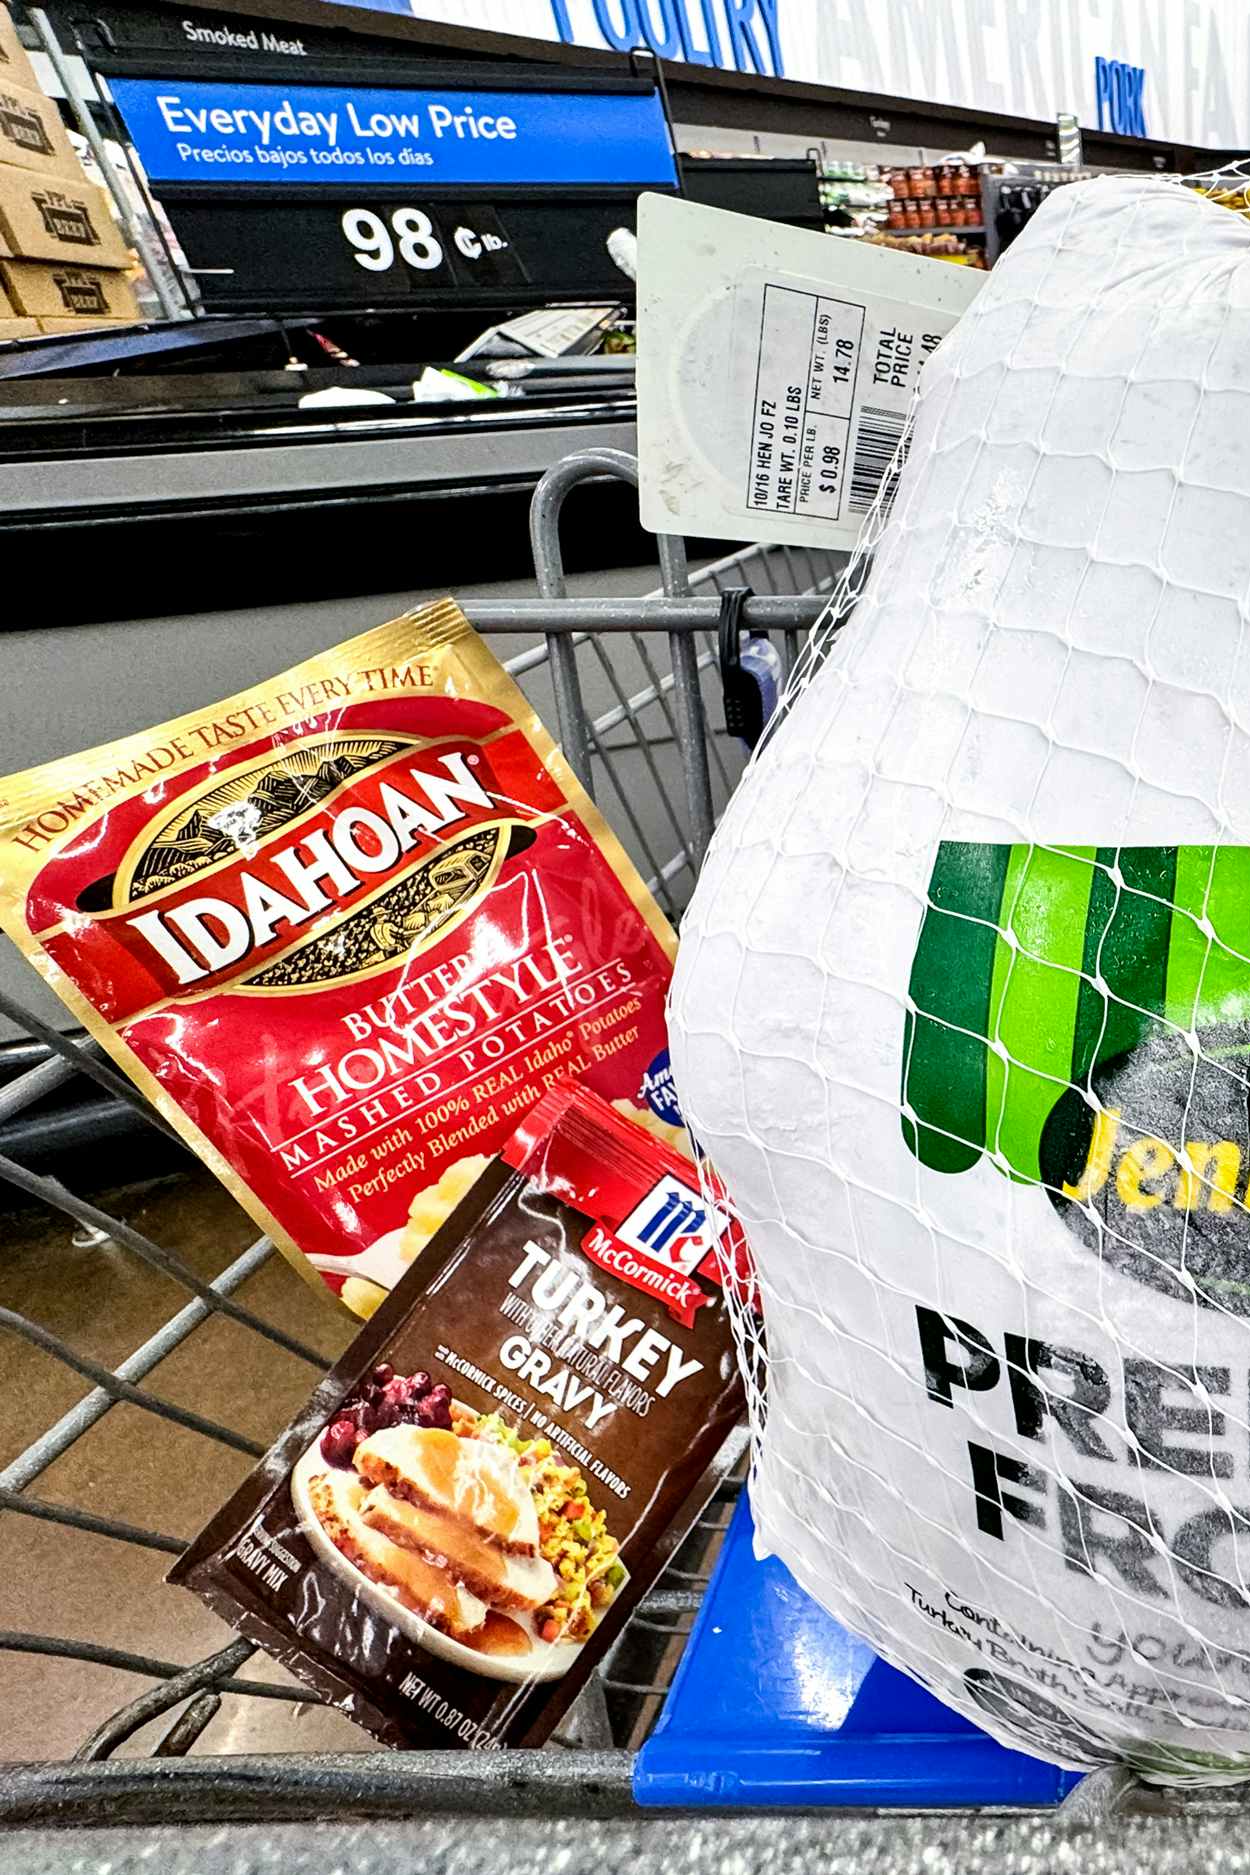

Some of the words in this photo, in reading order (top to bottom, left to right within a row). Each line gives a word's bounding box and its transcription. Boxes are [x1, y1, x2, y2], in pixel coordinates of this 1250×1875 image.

[182, 21, 258, 50] Smoked
[262, 34, 307, 56] Meat
[1095, 56, 1146, 138] PORK
[157, 96, 337, 145] Everyday
[347, 103, 422, 138] Low
[430, 105, 517, 140] Price
[177, 142, 253, 163] Precios
[256, 146, 306, 168] bajos
[309, 148, 364, 165] todos
[366, 148, 395, 165] los
[398, 148, 433, 166] días
[342, 208, 444, 272] 98
[816, 314, 832, 345] (LBS)
[813, 351, 827, 374] WT.
[832, 338, 855, 383] 14.78
[873, 327, 896, 384] TOTAL
[891, 332, 913, 388] PRICE
[761, 400, 776, 419] FZ
[786, 385, 802, 412] LBS
[810, 377, 823, 400] NET
[760, 421, 775, 439] JO
[782, 416, 798, 444] 0.10
[806, 424, 817, 443] LB.
[757, 442, 773, 469] HEN
[780, 448, 795, 473] WT.
[802, 444, 814, 468] PER
[820, 445, 840, 480] 0.98
[754, 473, 770, 507] 10/16
[776, 477, 793, 509] TARE
[799, 472, 812, 503] PRICE
[819, 483, 836, 494] $
[12, 737, 194, 852] HOMEMADE
[189, 702, 278, 748] TASTE
[278, 675, 354, 720] EVERY
[356, 664, 434, 702] TIME
[126, 752, 500, 984] IDAHOAN
[287, 937, 584, 1117] HOMESTYLE
[279, 1070, 441, 1171] MASHED
[464, 962, 633, 1070] POTATOES
[313, 1152, 369, 1194] Made
[371, 1129, 413, 1161] with
[415, 1096, 470, 1136] 100%
[472, 1069, 524, 1105] REAL
[579, 995, 643, 1040] Potatoes
[347, 1151, 426, 1204] Perfectly
[429, 1112, 499, 1159] Blended
[500, 1084, 541, 1119] with
[543, 1055, 592, 1090] REAL
[594, 1024, 640, 1063] Butter
[588, 1228, 692, 1309] McCormick
[506, 1240, 704, 1399] TURKEY
[499, 1291, 531, 1329] WITH
[524, 1309, 562, 1357] OHER
[558, 1334, 608, 1386] NATURAL
[602, 1369, 656, 1418] FLAVORS
[500, 1335, 619, 1430] GRAVY
[493, 1381, 528, 1416] SPICES
[529, 1408, 546, 1430] NO
[543, 1419, 596, 1469] ARTIFICIAL
[590, 1457, 632, 1500] FLAVORS
[237, 1538, 271, 1576] GRAVY
[262, 1563, 289, 1593] MIX
[398, 1671, 426, 1700] NET
[418, 1686, 442, 1713] WT
[435, 1701, 463, 1730] 0.87
[457, 1718, 478, 1742] OZ
